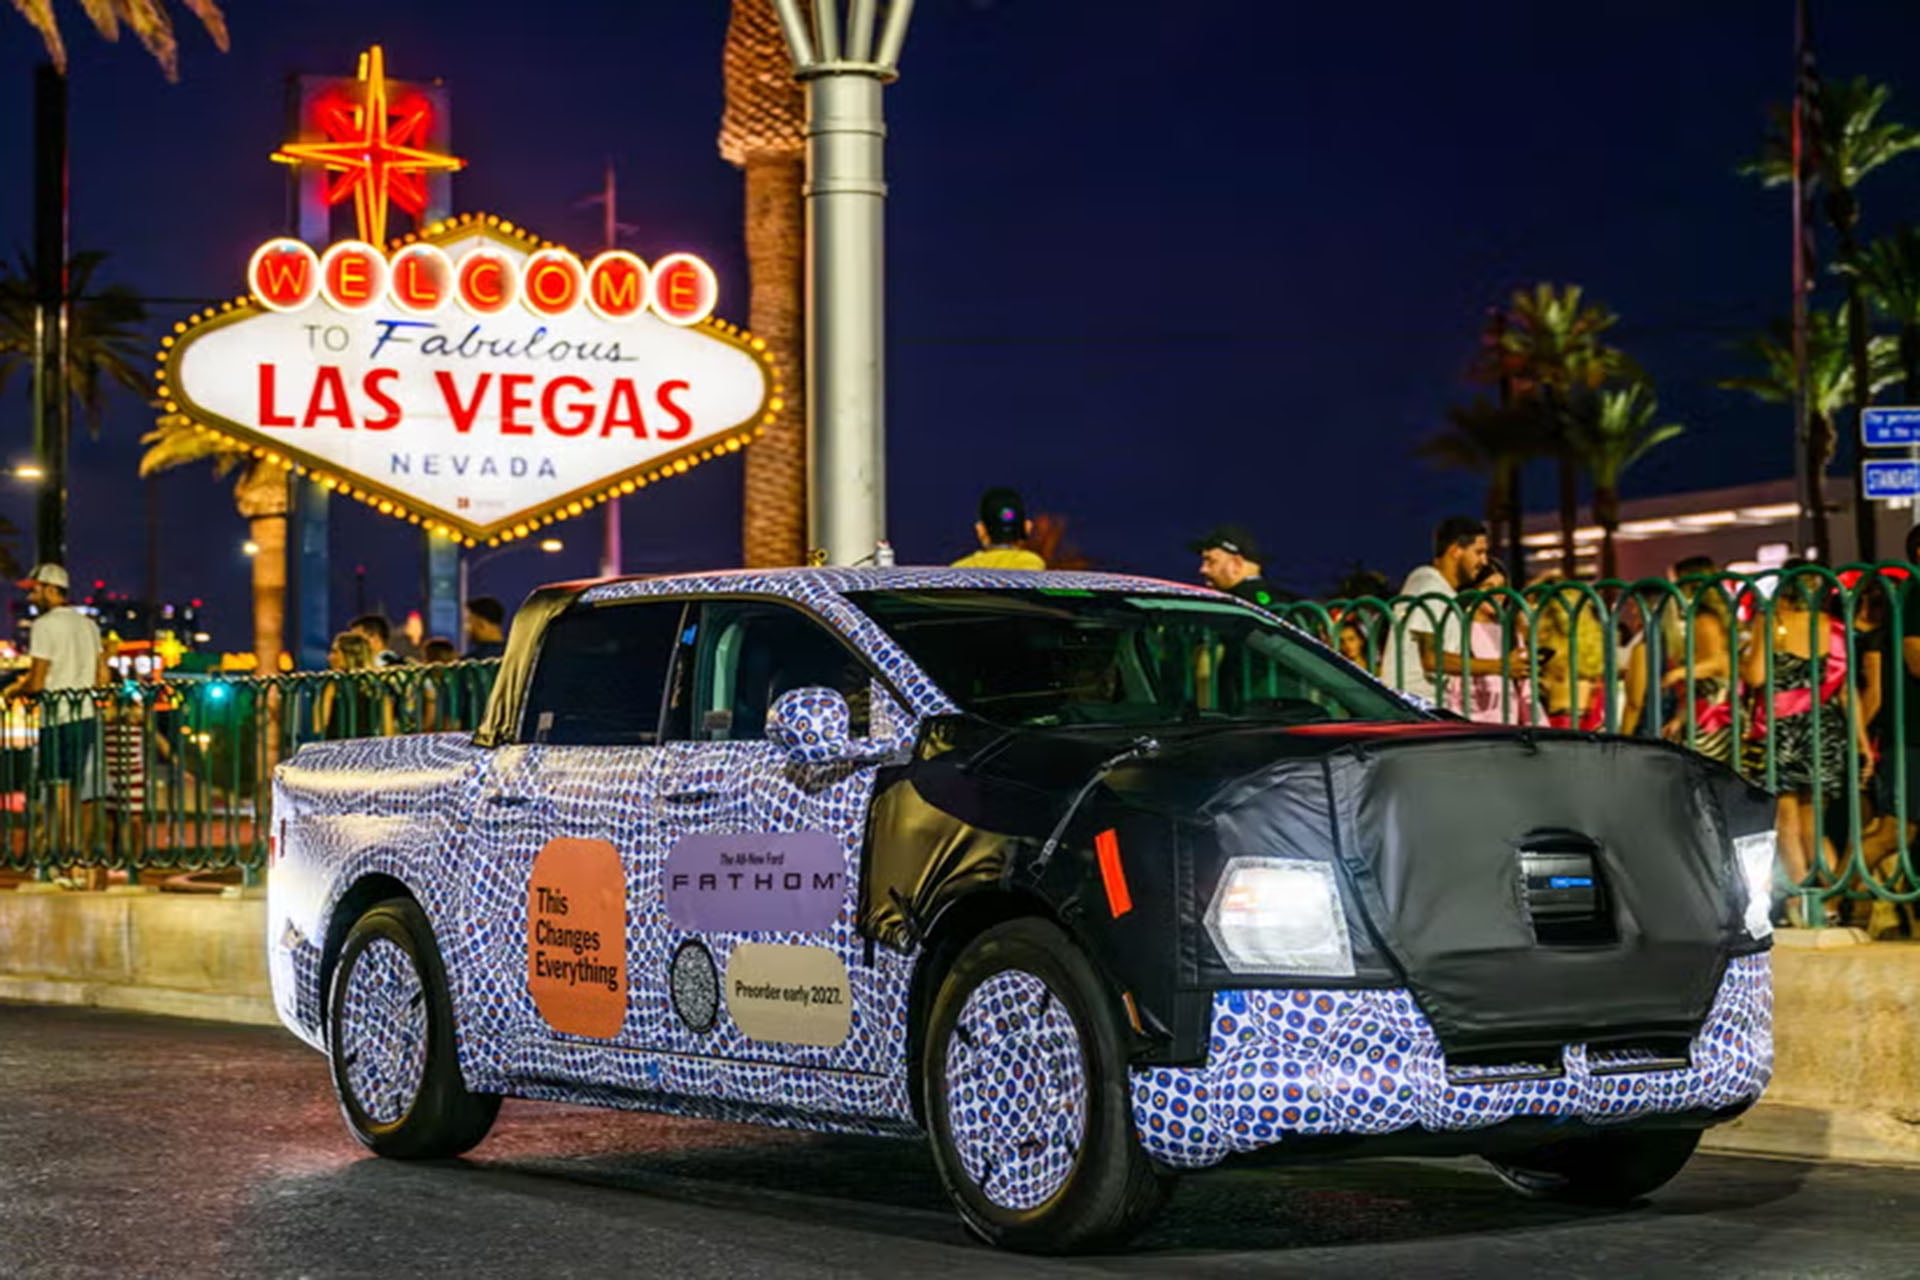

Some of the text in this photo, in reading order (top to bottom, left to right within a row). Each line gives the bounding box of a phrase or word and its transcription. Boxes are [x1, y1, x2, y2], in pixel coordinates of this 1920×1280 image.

[263, 257, 698, 313] WELCOME
[303, 319, 639, 362] TO Fabulous
[258, 363, 694, 441] LAS VEGAS
[391, 453, 557, 479] NEVADA
[720, 853, 734, 866] The
[766, 852, 785, 866] Ford
[536, 886, 568, 916] This
[535, 918, 601, 955] Changes
[535, 950, 619, 992] Everything
[735, 979, 781, 1000] Preorder
[783, 984, 810, 1008] early
